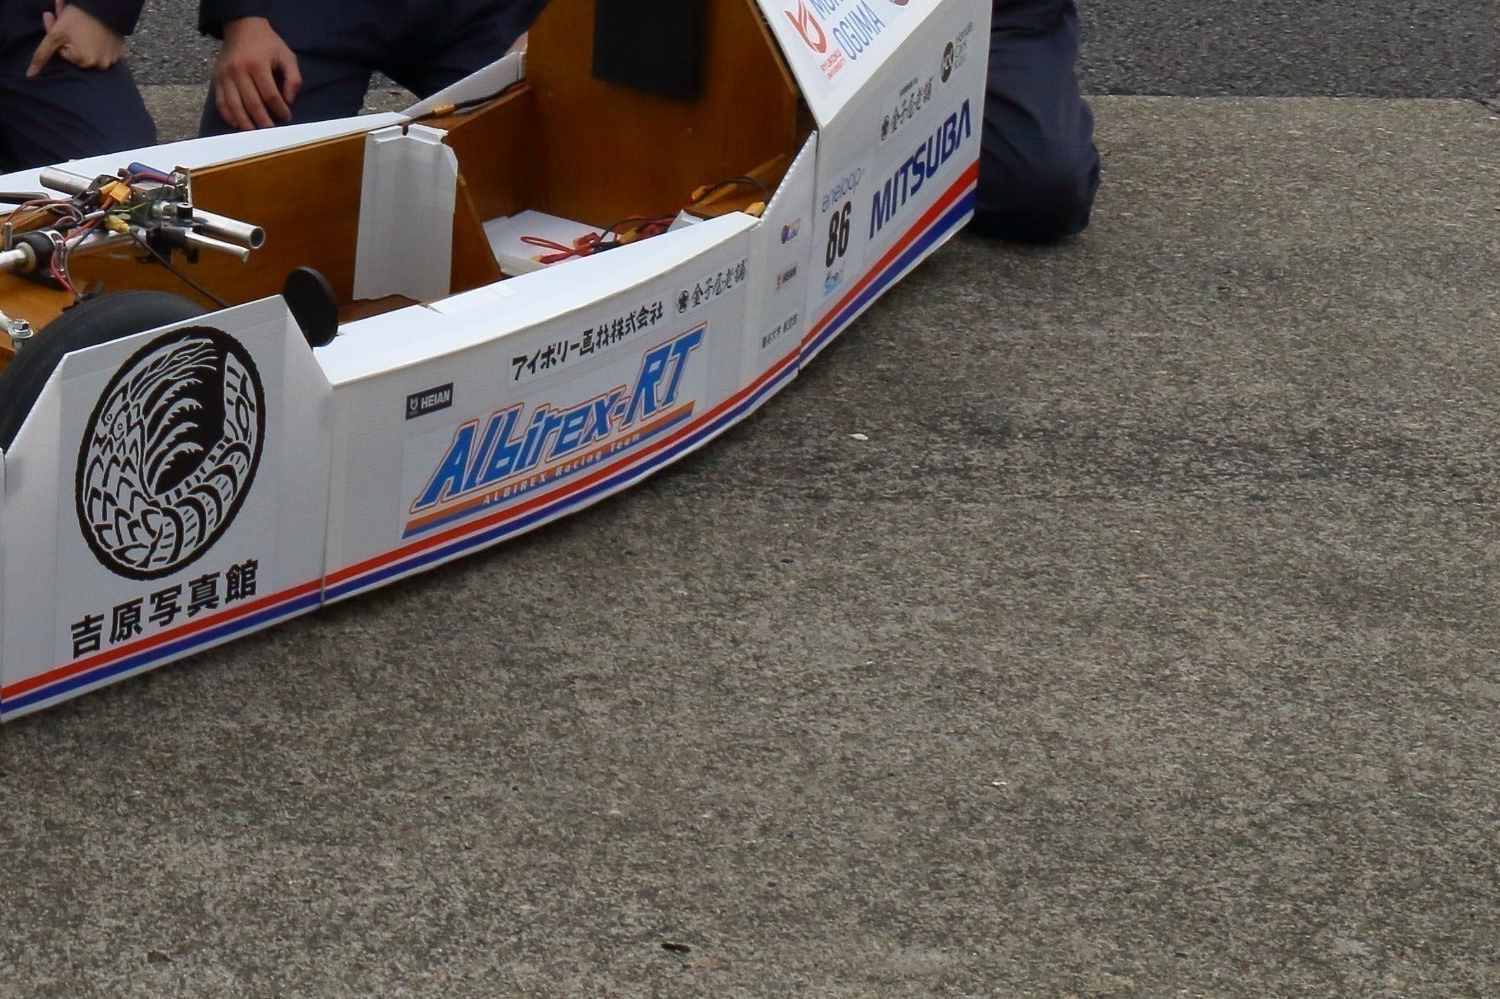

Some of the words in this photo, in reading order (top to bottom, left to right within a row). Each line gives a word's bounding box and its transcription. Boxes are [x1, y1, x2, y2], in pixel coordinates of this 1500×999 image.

[832, 0, 886, 61] OGUMA
[869, 98, 971, 240] MITSUBA
[826, 201, 852, 268] 86
[421, 390, 451, 409] HEIAN
[482, 472, 547, 505] ALBIREX
[70, 559, 259, 659] 吉原写真館
